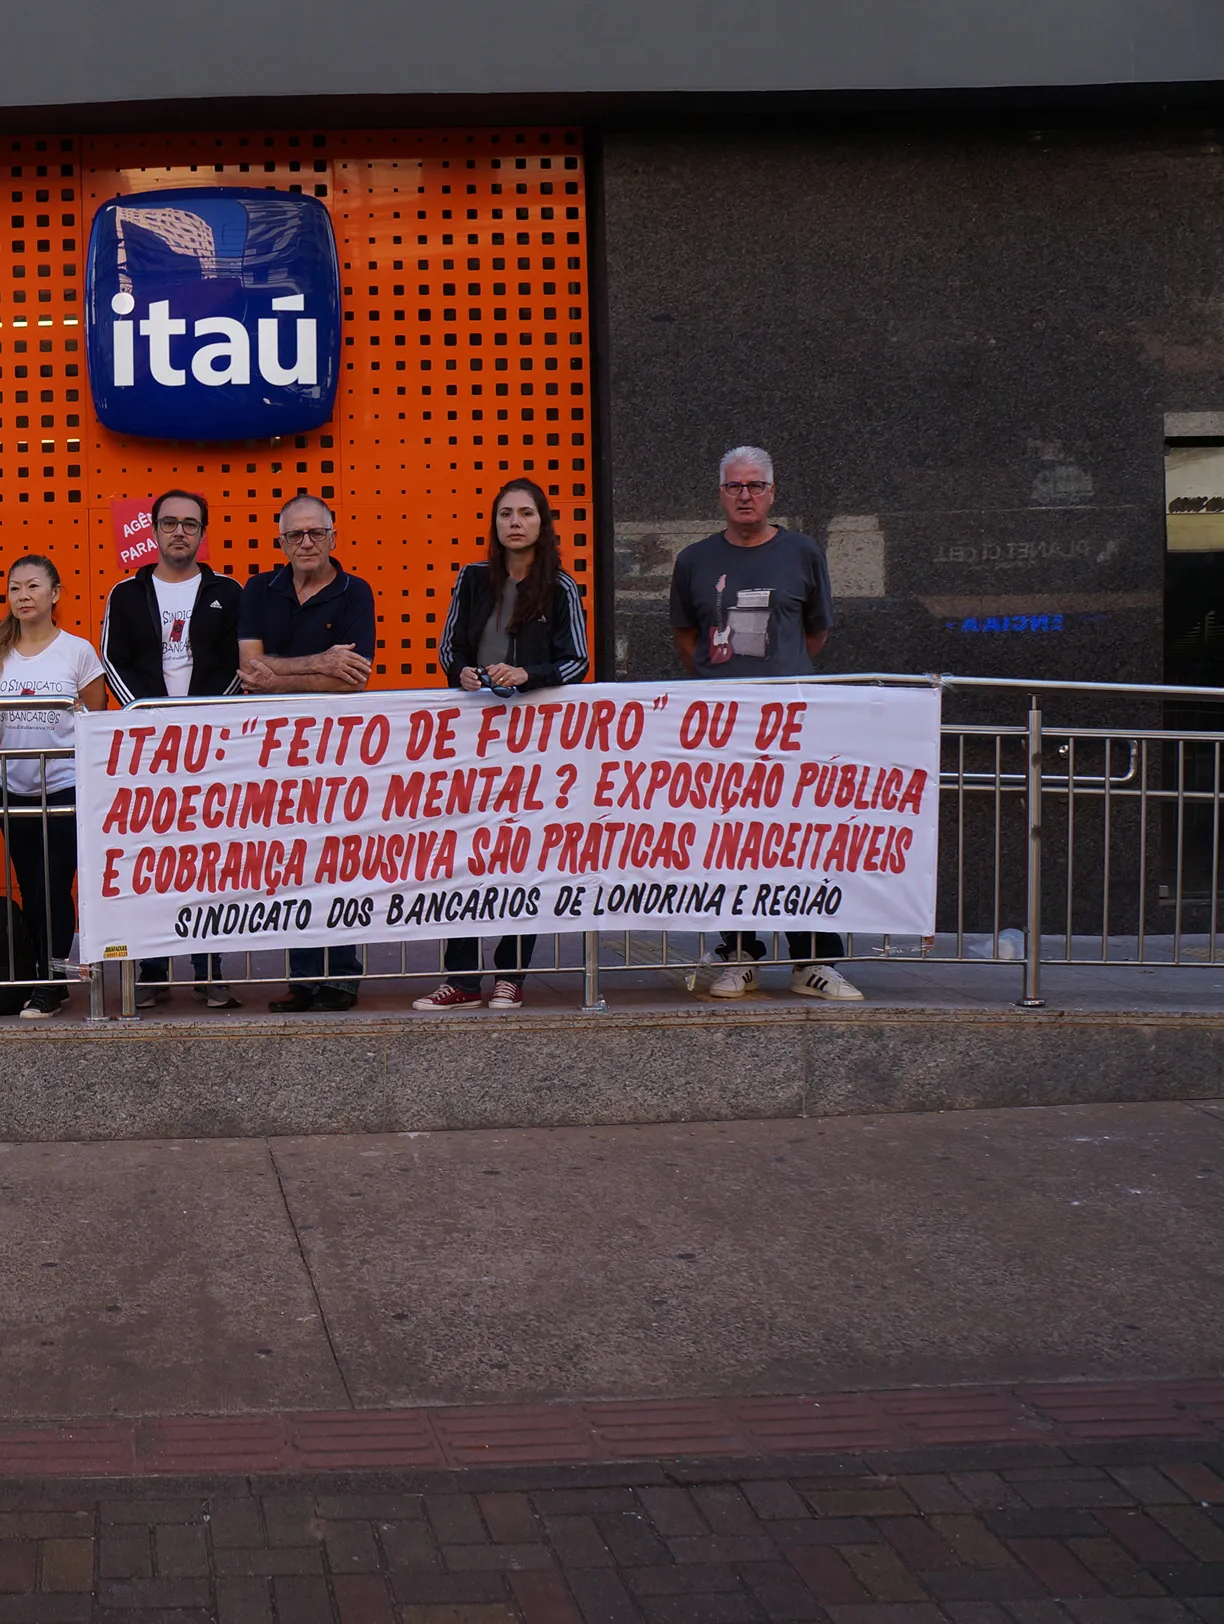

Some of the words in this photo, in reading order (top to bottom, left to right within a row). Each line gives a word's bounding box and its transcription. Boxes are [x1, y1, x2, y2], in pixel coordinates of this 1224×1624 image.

[111, 290, 317, 387] itaú
[106, 725, 231, 777] ITAU:
[405, 707, 461, 761] DE
[679, 700, 739, 751] OU
[754, 701, 808, 751] DE
[102, 775, 369, 835] ADOECIMENTO
[593, 754, 785, 815] EXPOSIÇÃO
[792, 754, 928, 815] PÚBLICA
[101, 848, 125, 898] E
[131, 838, 308, 896] COBRANÇA
[314, 829, 458, 884] ABUSIVA
[467, 817, 532, 877] SÃO
[537, 813, 697, 875] PRÁTICAS
[702, 814, 914, 875] INACEITÁVEIS
[174, 898, 313, 939] SINDICATO
[326, 896, 374, 929] DOS
[386, 882, 541, 926] BANCÁRIOS
[553, 885, 583, 917] DE
[593, 882, 723, 916] LONDRINA
[731, 884, 748, 916] E
[751, 877, 843, 917] REGIÃO
